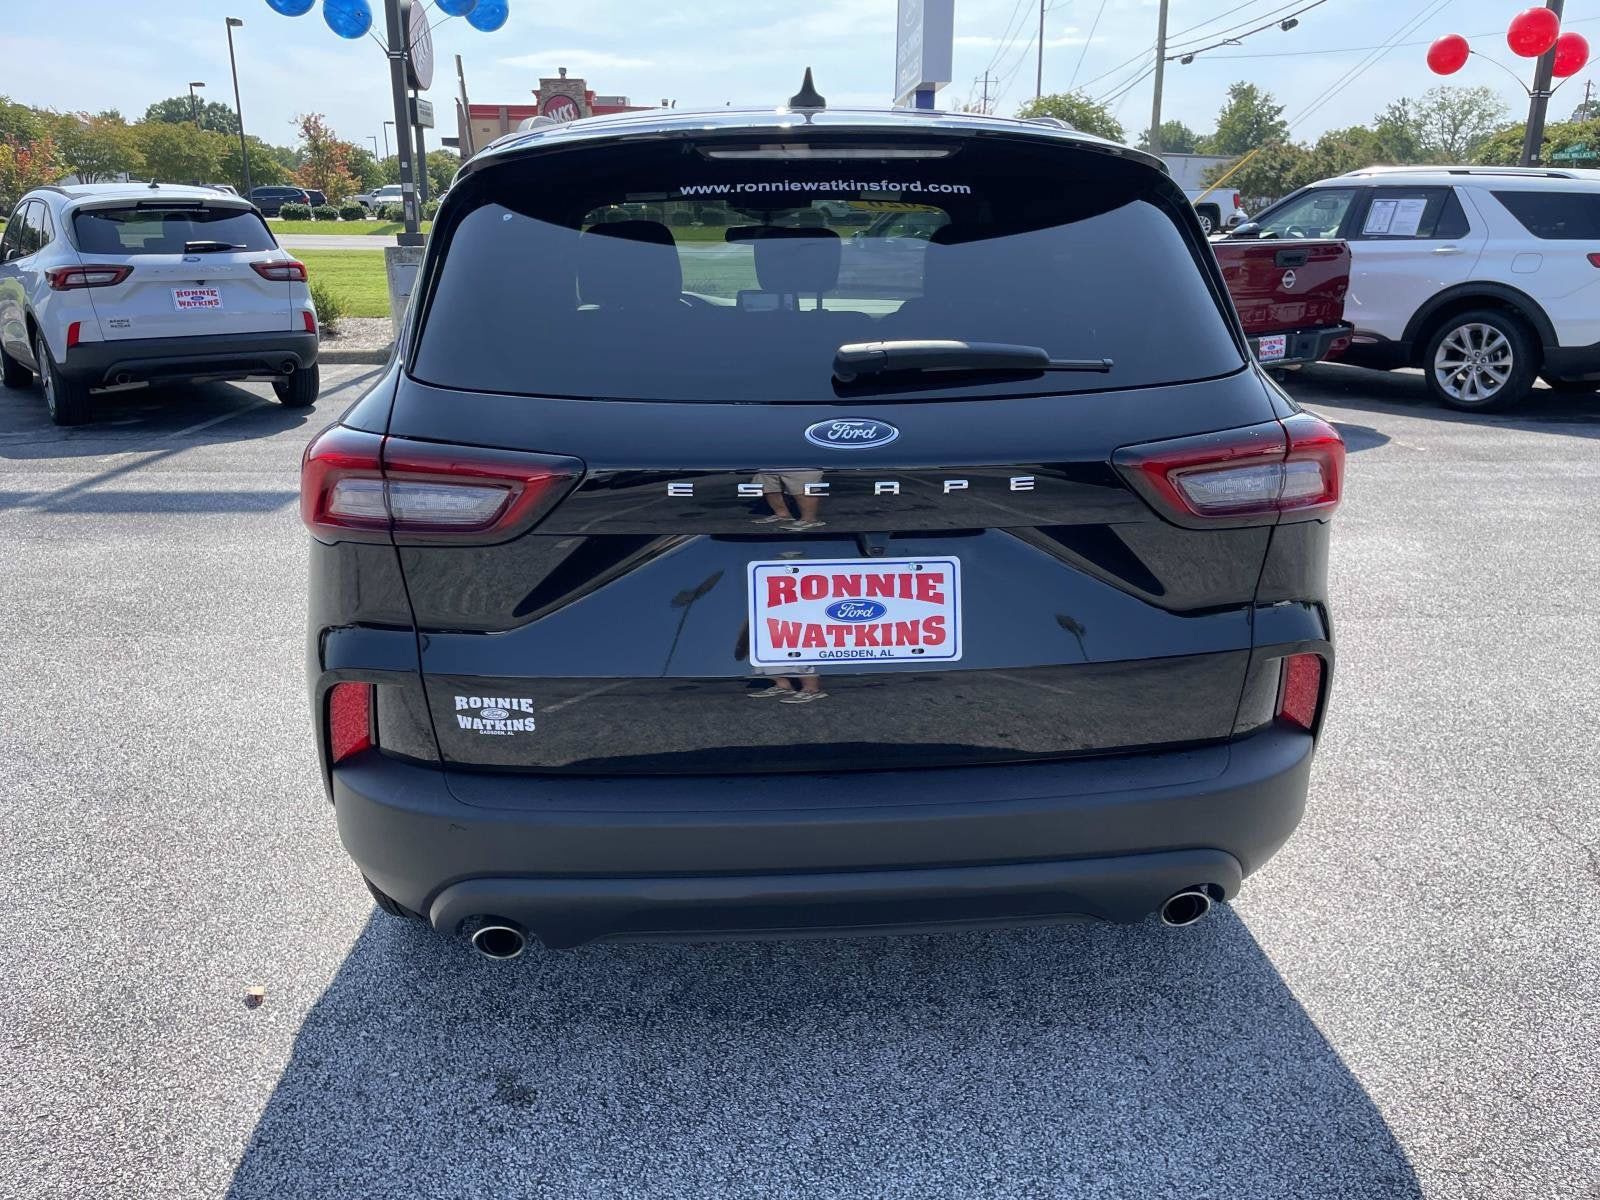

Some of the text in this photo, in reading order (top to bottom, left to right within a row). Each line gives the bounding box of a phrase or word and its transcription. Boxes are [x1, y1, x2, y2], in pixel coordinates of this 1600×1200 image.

[679, 179, 971, 196] www.ronniewatkinsford.com
[177, 299, 220, 307] WATKINS
[827, 421, 877, 440] Ford
[667, 476, 1035, 498] ESCAPE
[766, 572, 945, 608] RONNIE
[837, 601, 875, 619] Ford
[766, 615, 947, 649] WATKINS
[818, 649, 895, 659] GADSDEN, AL
[454, 695, 534, 714] RONNIE
[456, 714, 536, 732] WATKINS
